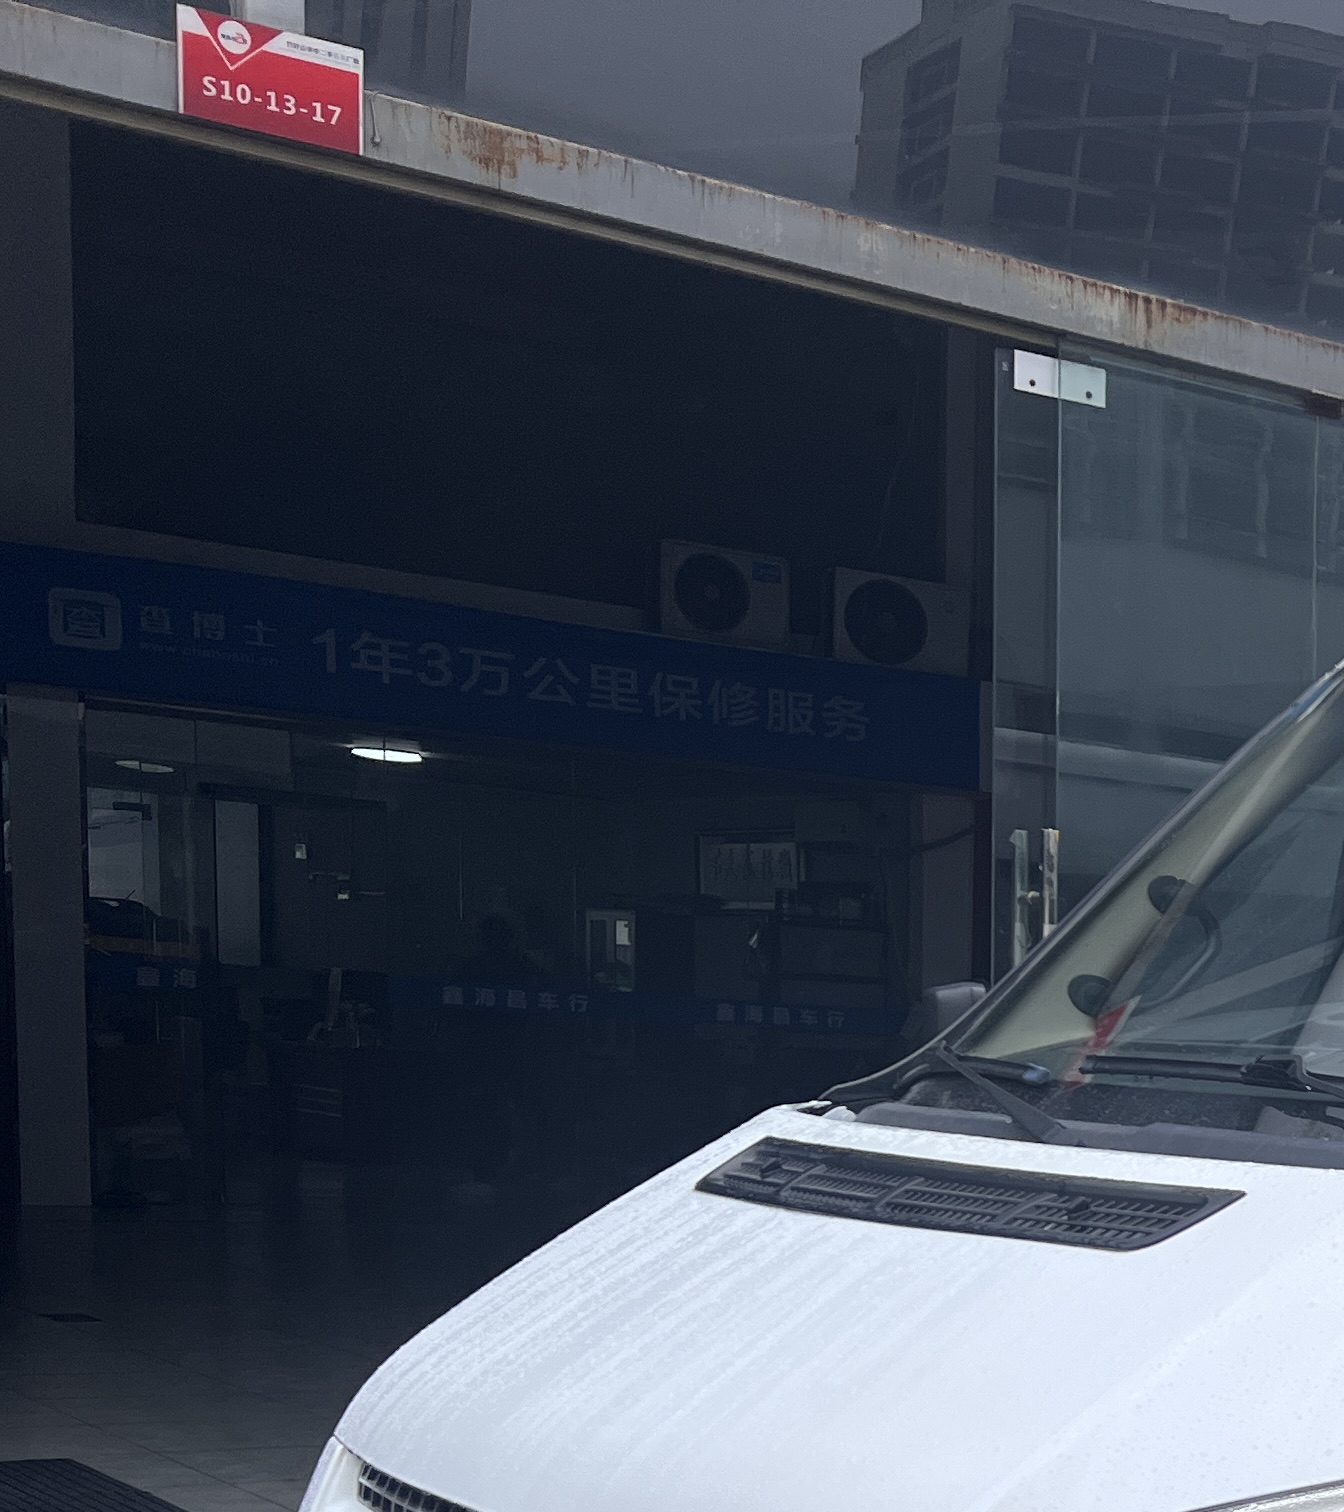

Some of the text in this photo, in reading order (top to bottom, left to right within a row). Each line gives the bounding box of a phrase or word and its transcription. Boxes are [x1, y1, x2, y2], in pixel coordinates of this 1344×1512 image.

[202, 75, 342, 126] S10-13-17
[311, 628, 870, 743] 1年3万公里保修服务
